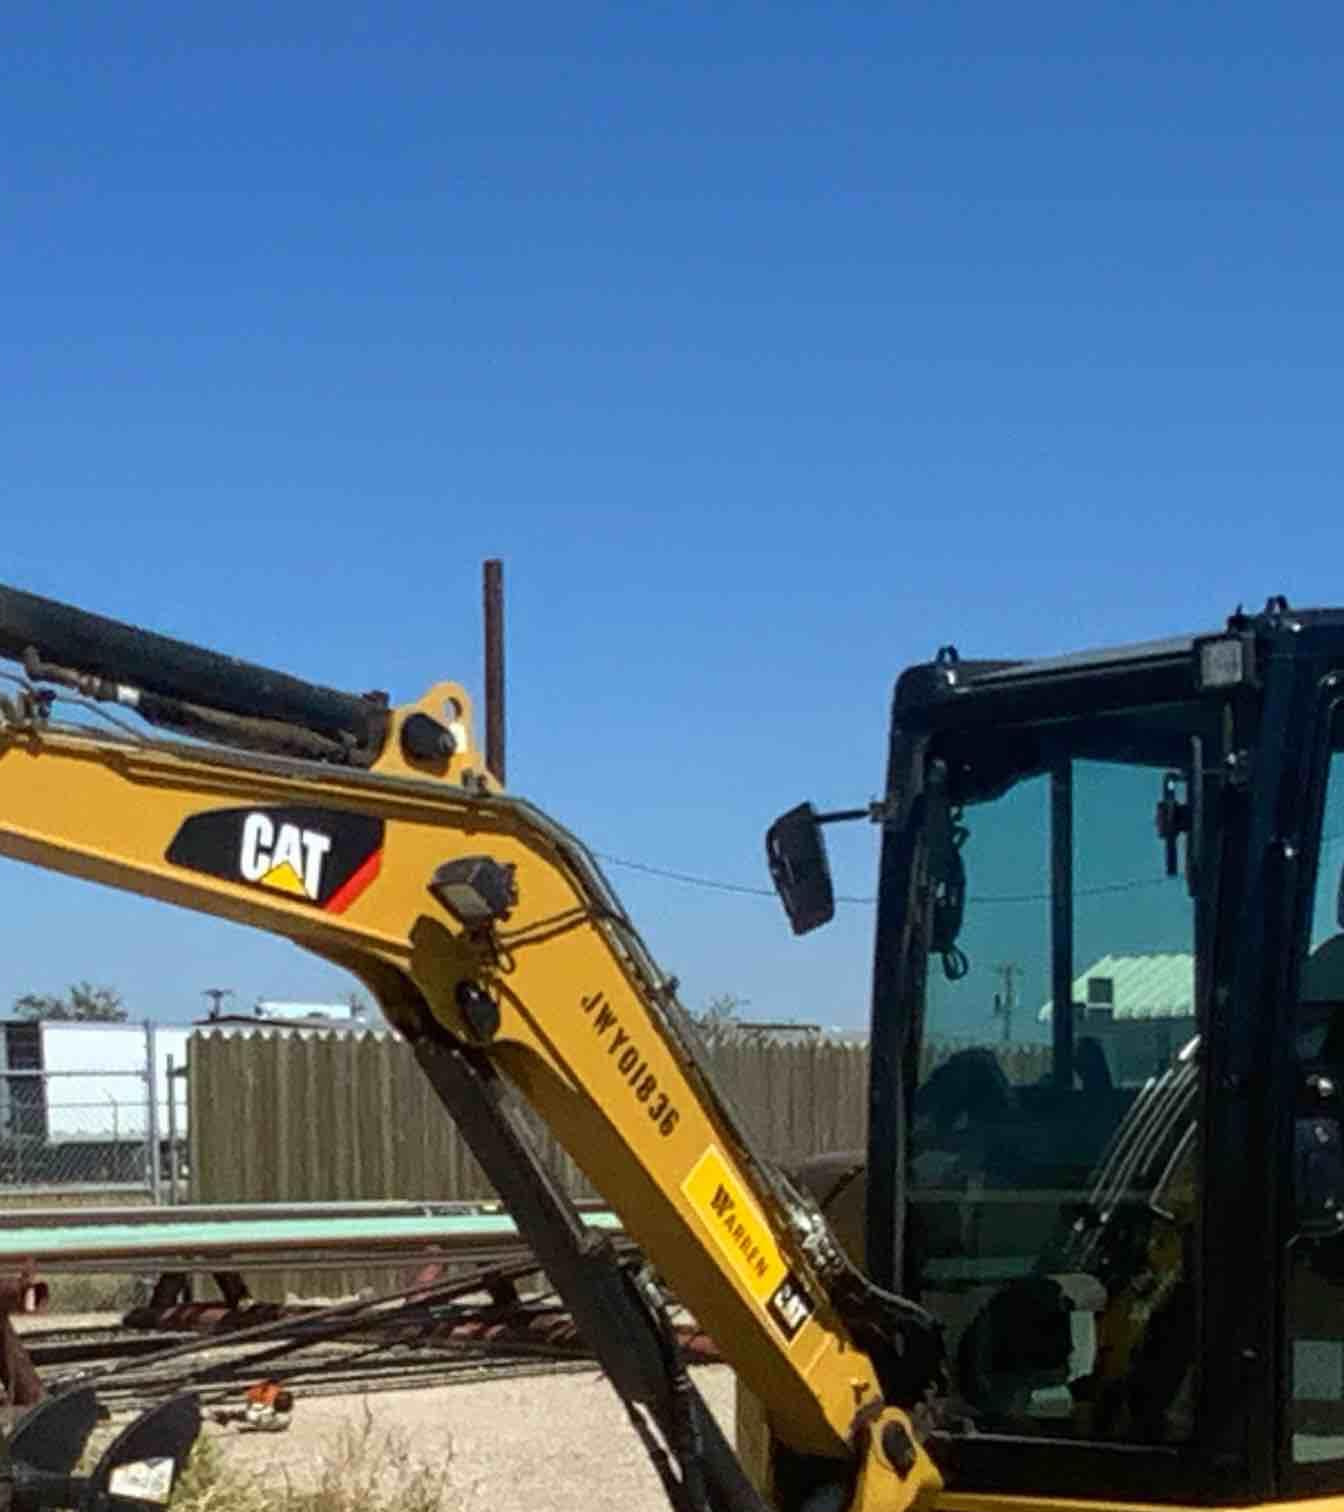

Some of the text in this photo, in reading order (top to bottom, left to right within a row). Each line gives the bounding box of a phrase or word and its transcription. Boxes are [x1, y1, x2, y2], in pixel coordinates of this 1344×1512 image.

[240, 812, 331, 899] CAT
[580, 991, 680, 1136] JWY01836
[710, 1183, 769, 1278] WARREN
